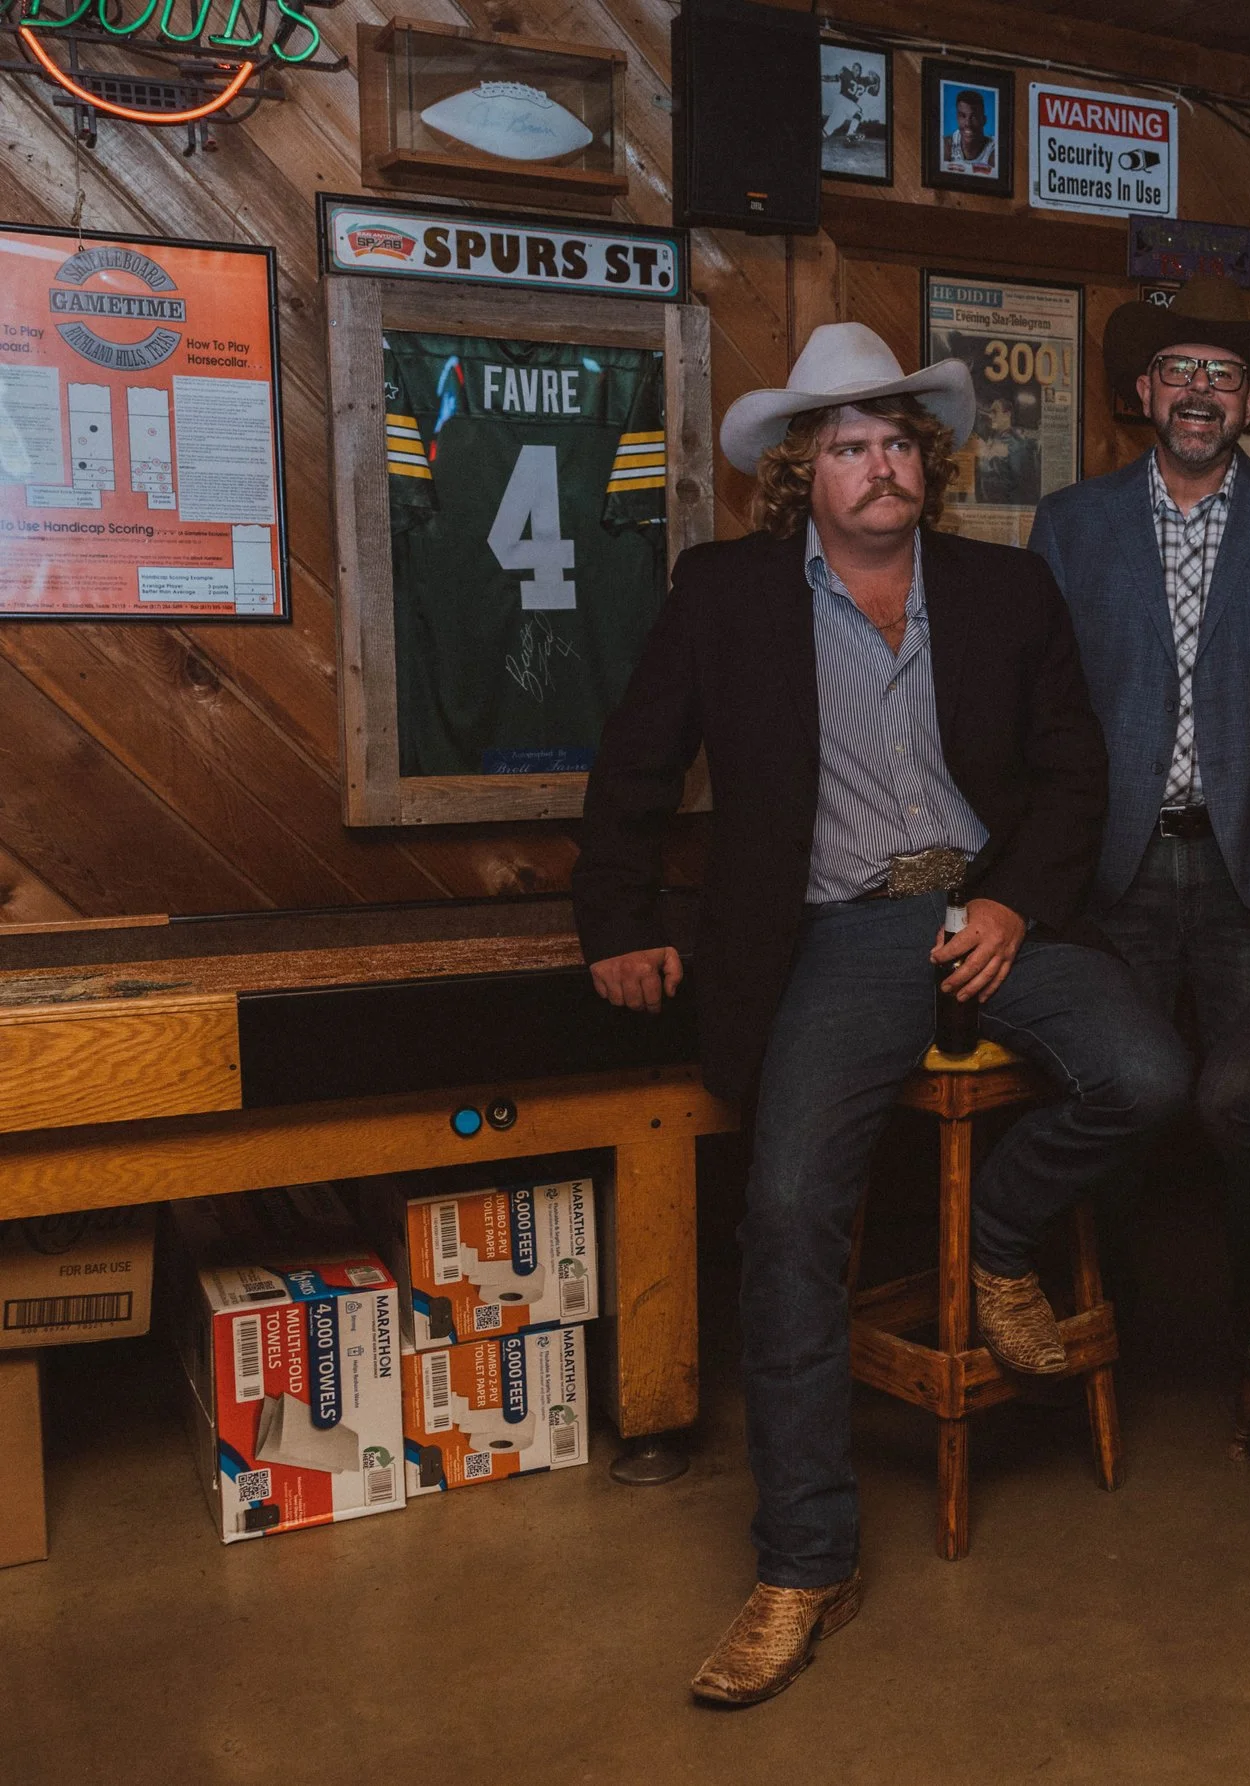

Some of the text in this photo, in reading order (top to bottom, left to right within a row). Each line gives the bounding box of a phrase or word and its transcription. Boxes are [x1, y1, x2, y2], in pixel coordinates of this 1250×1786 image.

[848, 80, 865, 98] 32
[1045, 98, 1163, 138] WARNING
[1047, 137, 1113, 174] Security
[1048, 168, 1161, 205] Cameras In Use
[63, 249, 168, 289] SHUFFLEBOARD
[423, 227, 671, 288] SPURS ST.
[52, 291, 183, 319] GAMETIME
[933, 286, 953, 300] HE
[957, 289, 983, 303] DID
[986, 292, 999, 305] IT
[4, 324, 45, 340] To Play
[955, 309, 990, 326] Evening
[992, 312, 1051, 330] Star-Telegram
[64, 325, 176, 367] RICHLAND HILLS, TEXAS
[186, 337, 250, 354] How To Play
[983, 339, 1072, 387] 300!
[484, 364, 581, 414] FAVRE
[1, 520, 154, 537] To Use Handicap Scoring
[487, 445, 577, 609] 4
[484, 1196, 496, 1259] TOILET PAPER
[496, 1193, 508, 1254] JUMBO 2-PLY
[514, 1190, 532, 1230] 6,000
[572, 1182, 586, 1256] MARATHON
[59, 1261, 132, 1276] FOR BAR USE
[287, 1270, 317, 1295] 16 PACKS
[265, 1311, 282, 1370] TOWELS
[314, 1304, 333, 1349] 4,000
[376, 1295, 391, 1378] MARATHON
[286, 1308, 303, 1394] MULTI-FOLD
[505, 1338, 523, 1378] 6,000
[563, 1330, 577, 1403] MARATHON
[475, 1345, 486, 1407] TOILET PAPER
[487, 1343, 498, 1402] JUMBO 2-PLY
